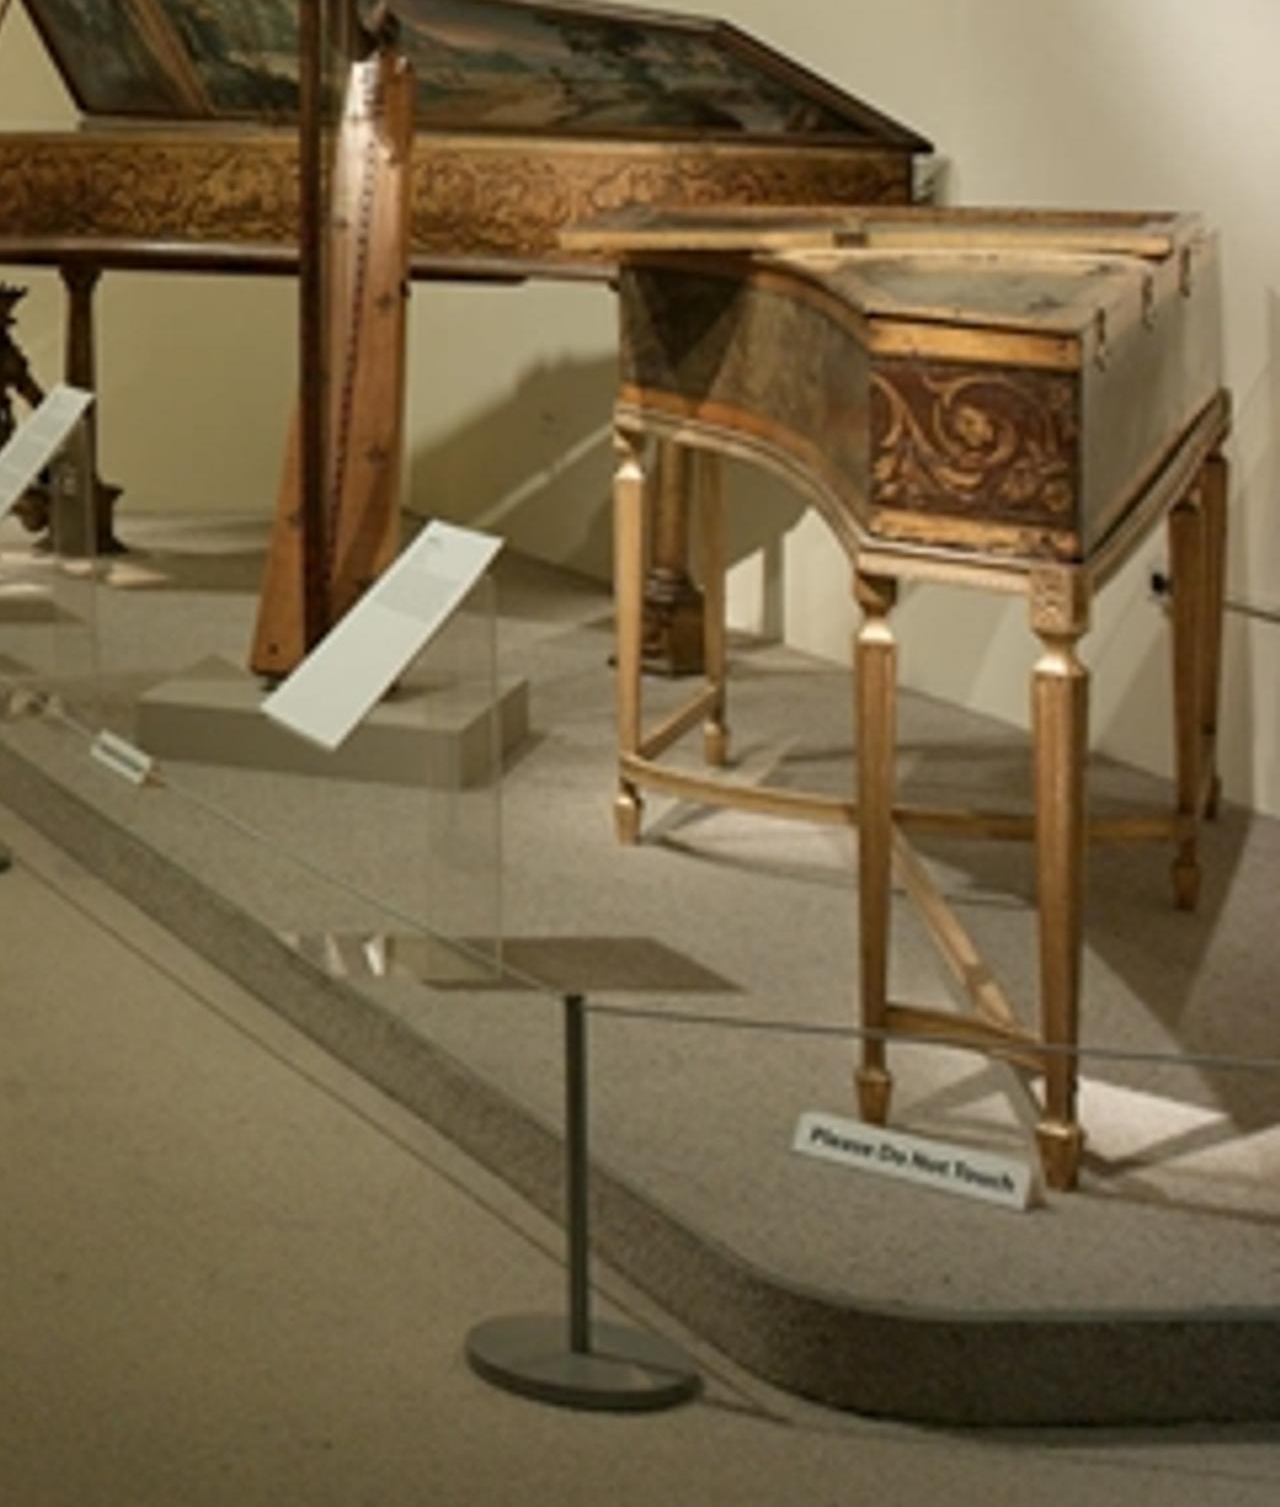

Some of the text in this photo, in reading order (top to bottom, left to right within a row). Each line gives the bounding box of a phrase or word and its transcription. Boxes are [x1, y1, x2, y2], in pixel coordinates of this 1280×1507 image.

[809, 1124, 1016, 1193] Please Do Not Touch
